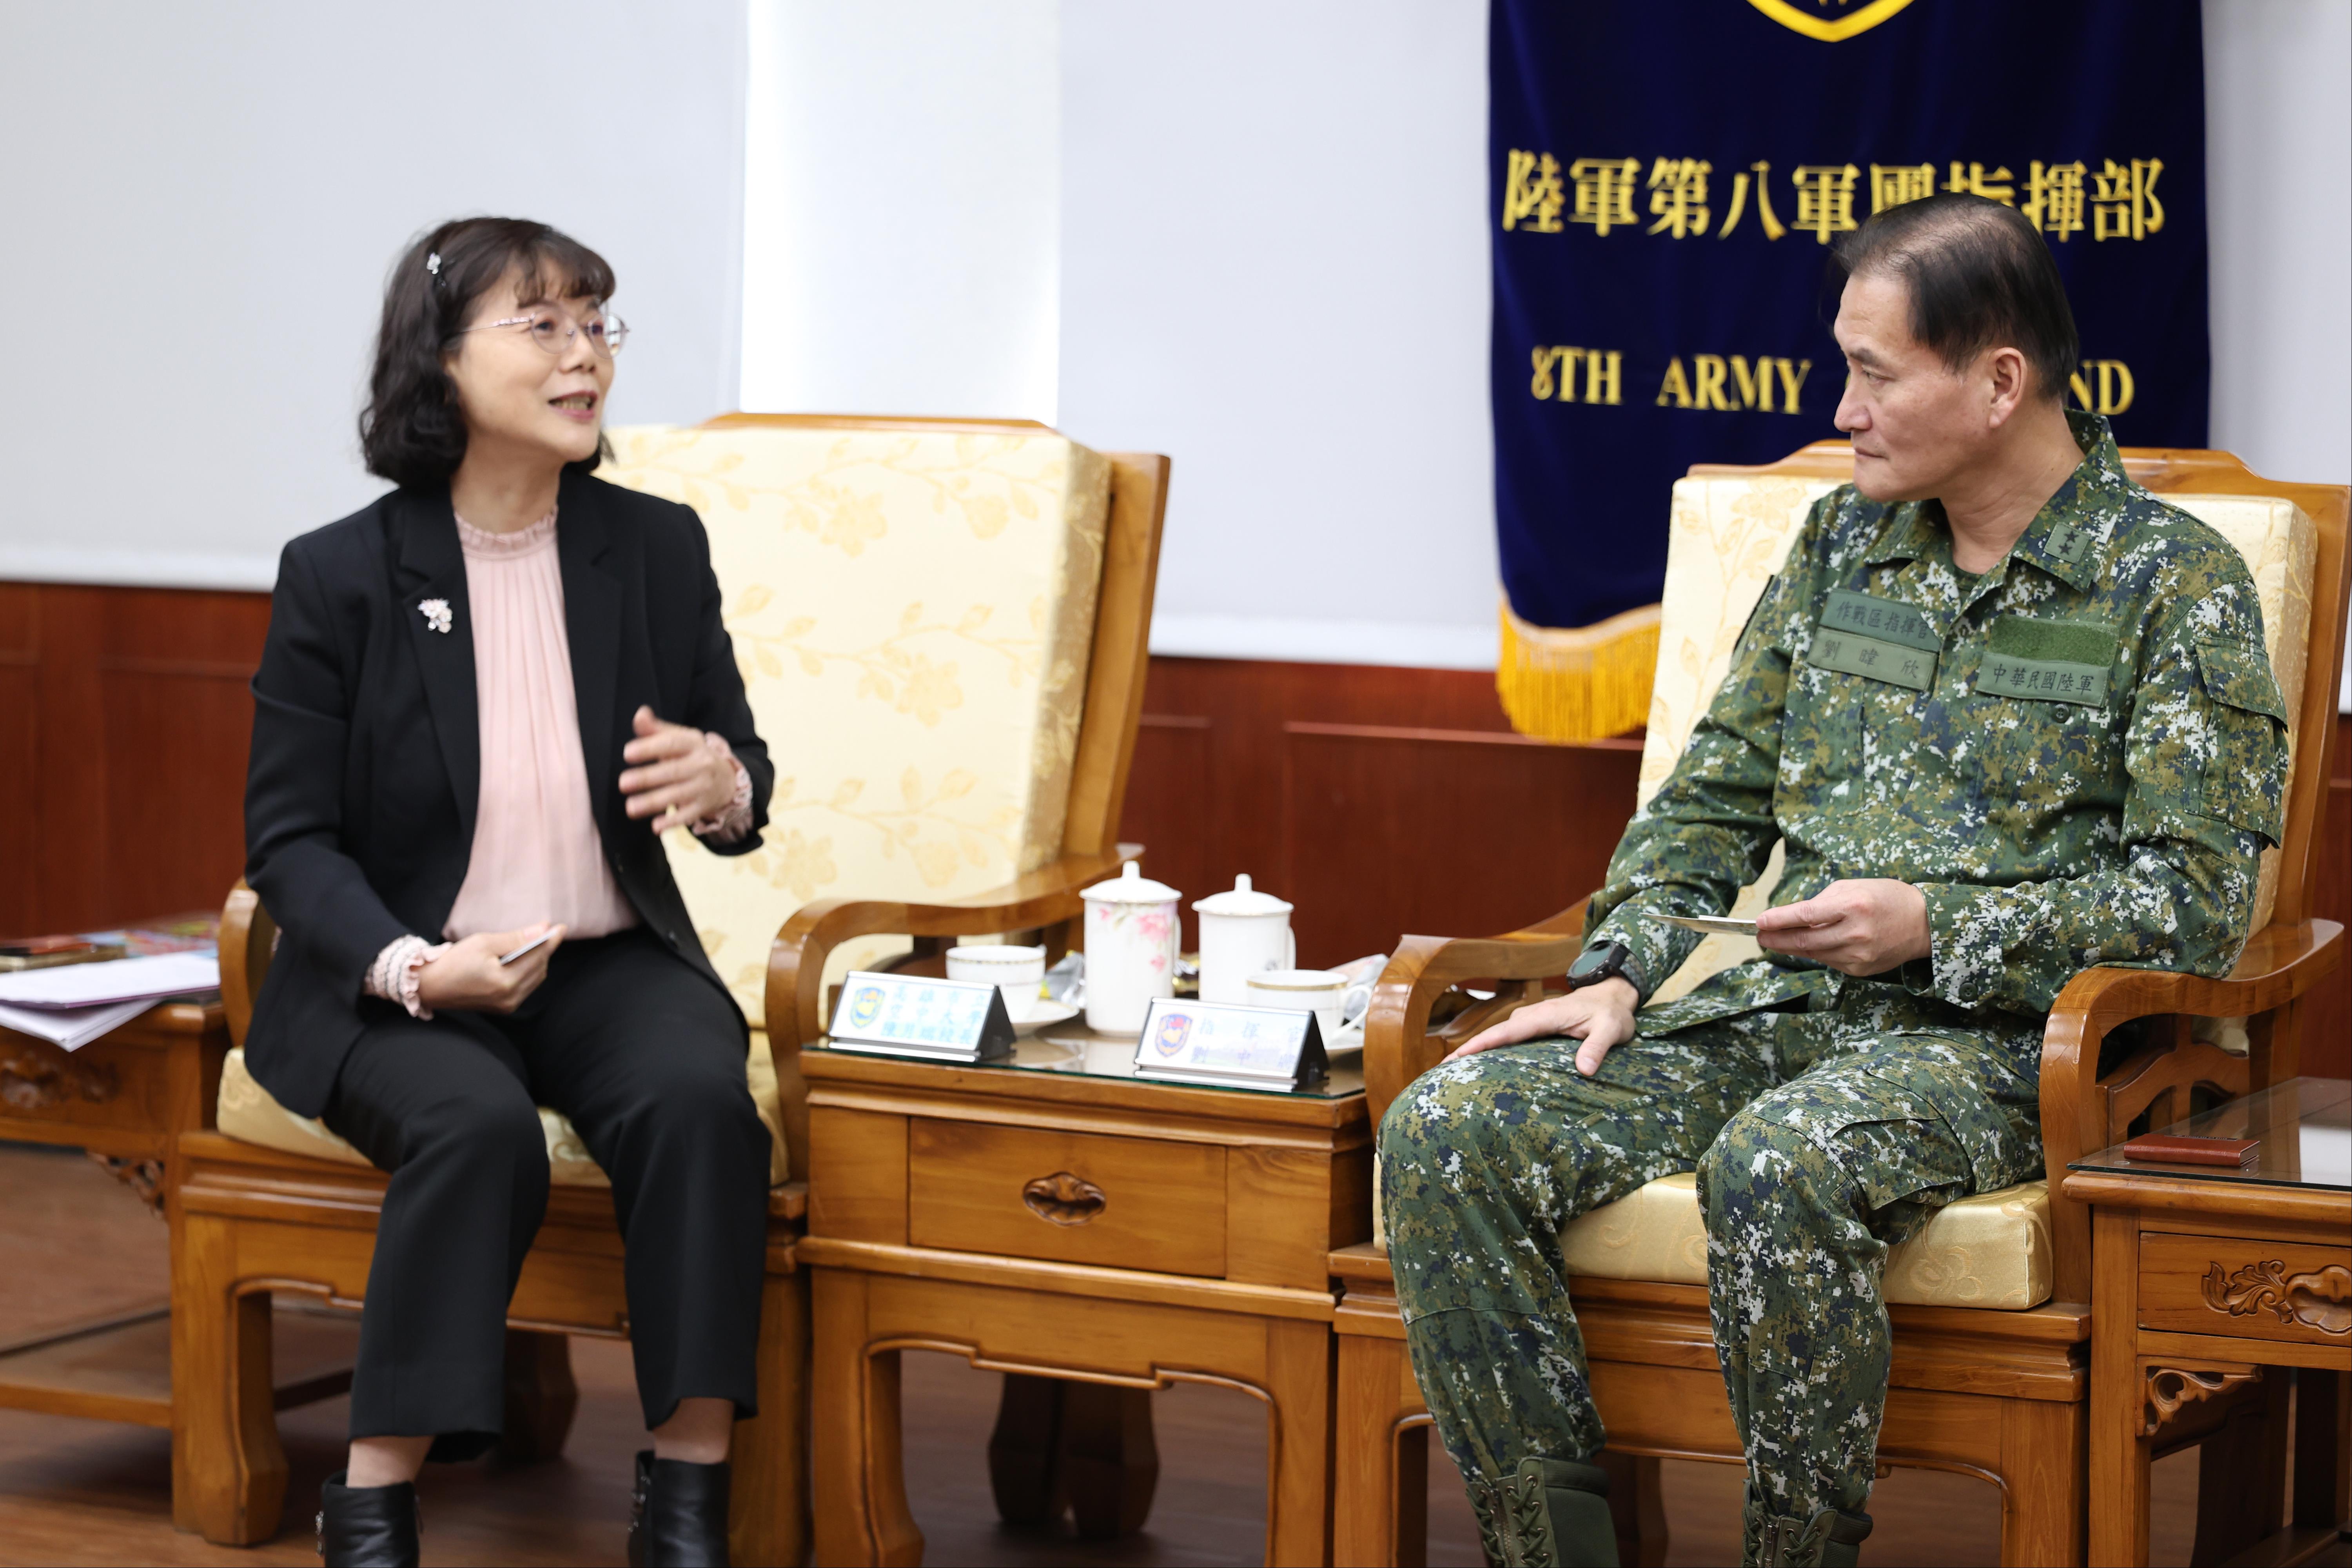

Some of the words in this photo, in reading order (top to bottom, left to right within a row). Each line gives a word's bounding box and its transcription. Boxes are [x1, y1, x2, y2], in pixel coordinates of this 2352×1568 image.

[1530, 345, 1624, 406] 8TH
[1655, 354, 1813, 415] ARMY
[1836, 601, 1929, 639] 作戰區指揮官
[1993, 663, 2094, 695] 中華民國陸軍
